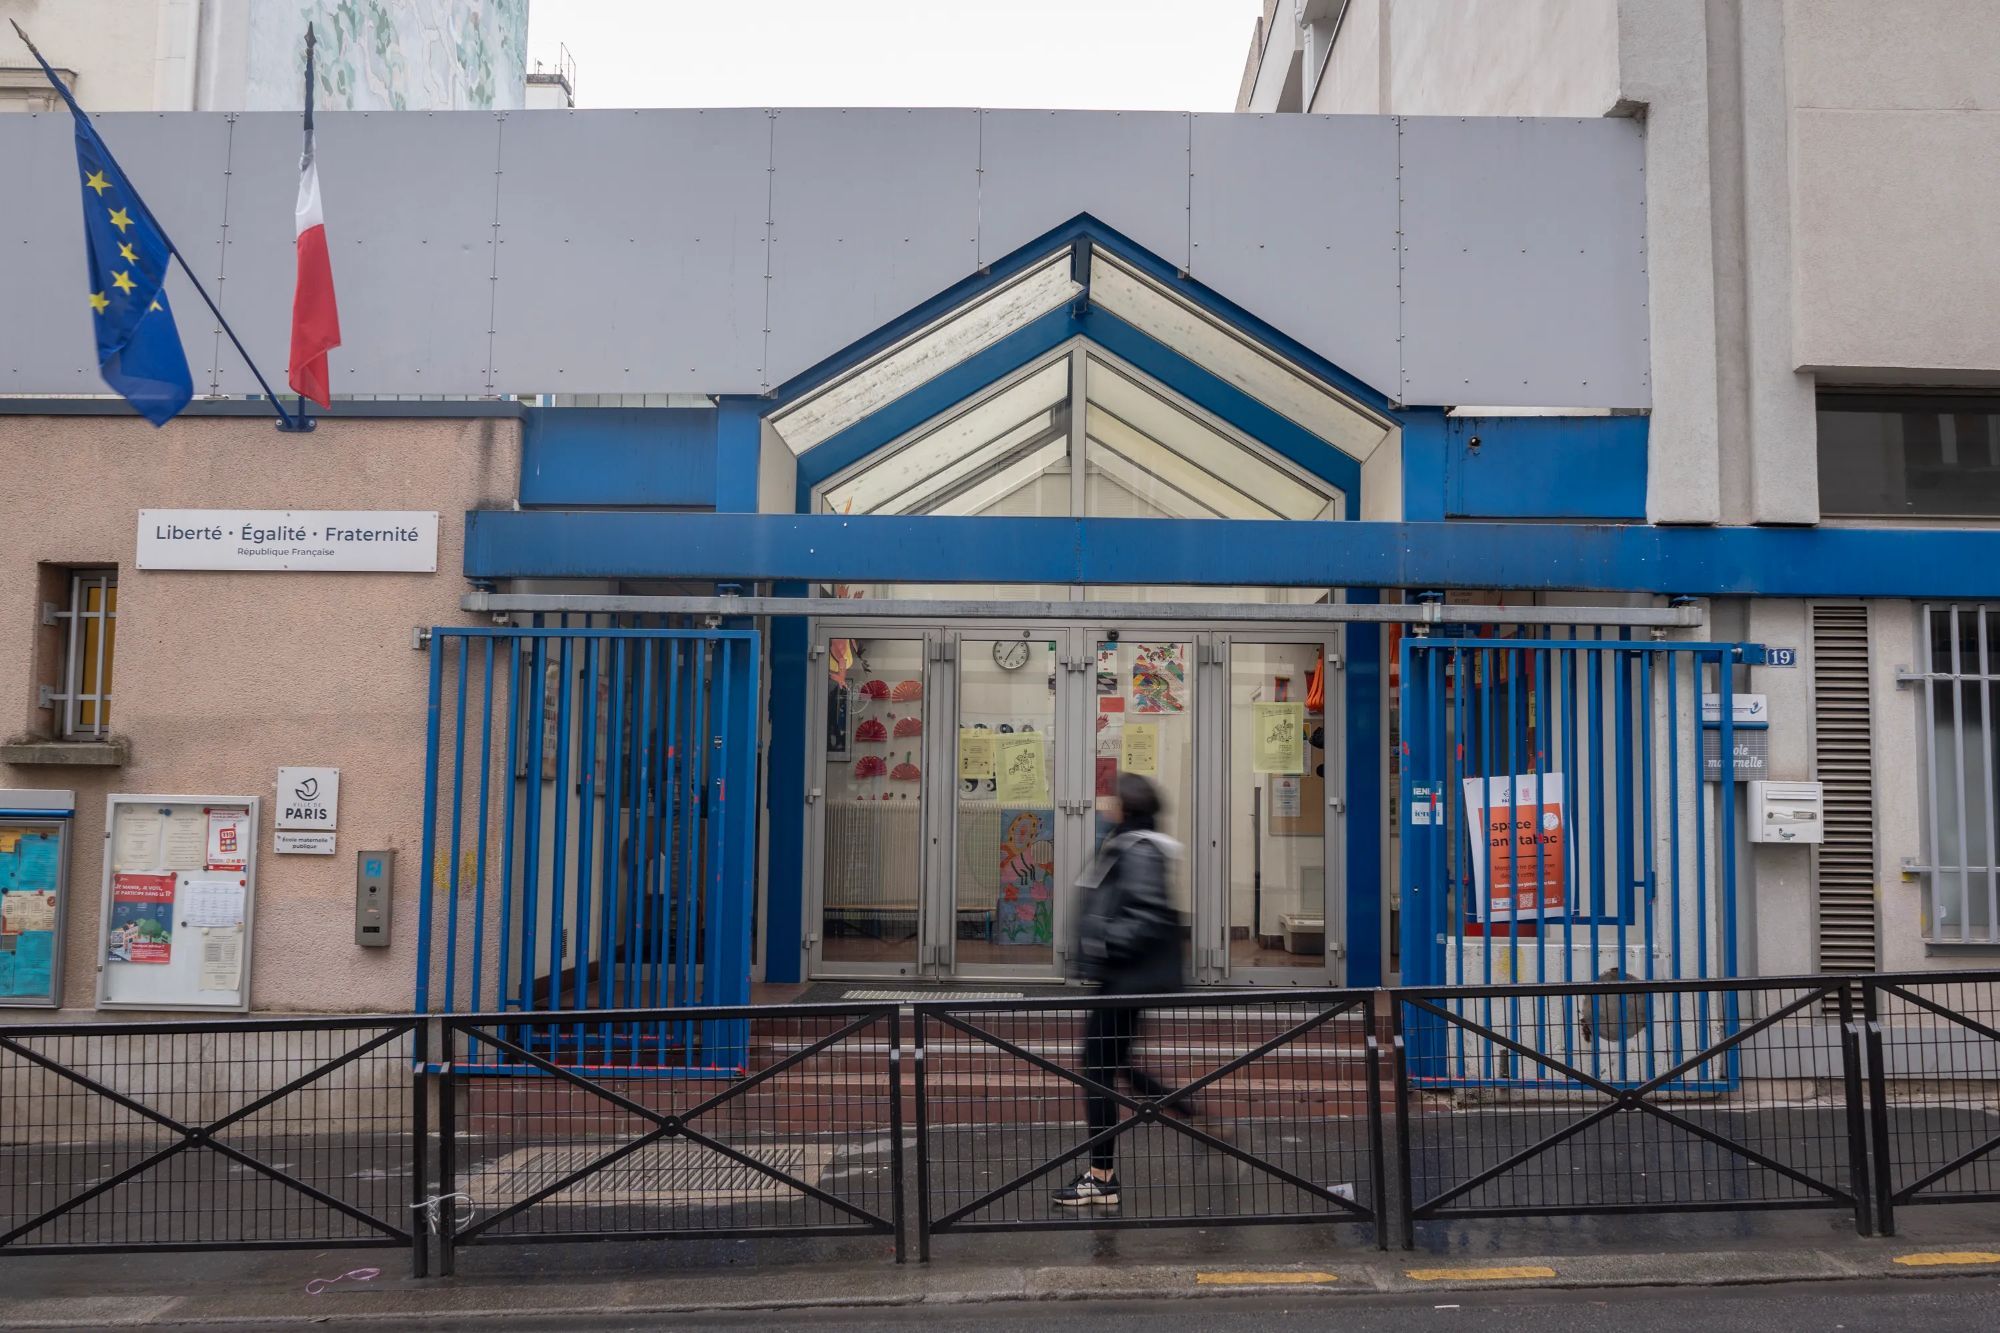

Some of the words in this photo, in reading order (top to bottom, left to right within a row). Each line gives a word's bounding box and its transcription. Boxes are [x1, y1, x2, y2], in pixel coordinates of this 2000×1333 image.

[156, 525, 222, 540] Liberté
[241, 523, 306, 544] Égalité
[326, 526, 419, 541] Fraternité
[237, 548, 290, 557] République
[291, 548, 335, 557] Française
[1771, 650, 1790, 664] 19
[285, 807, 327, 820] PARIS
[1489, 820, 1531, 832] spce
